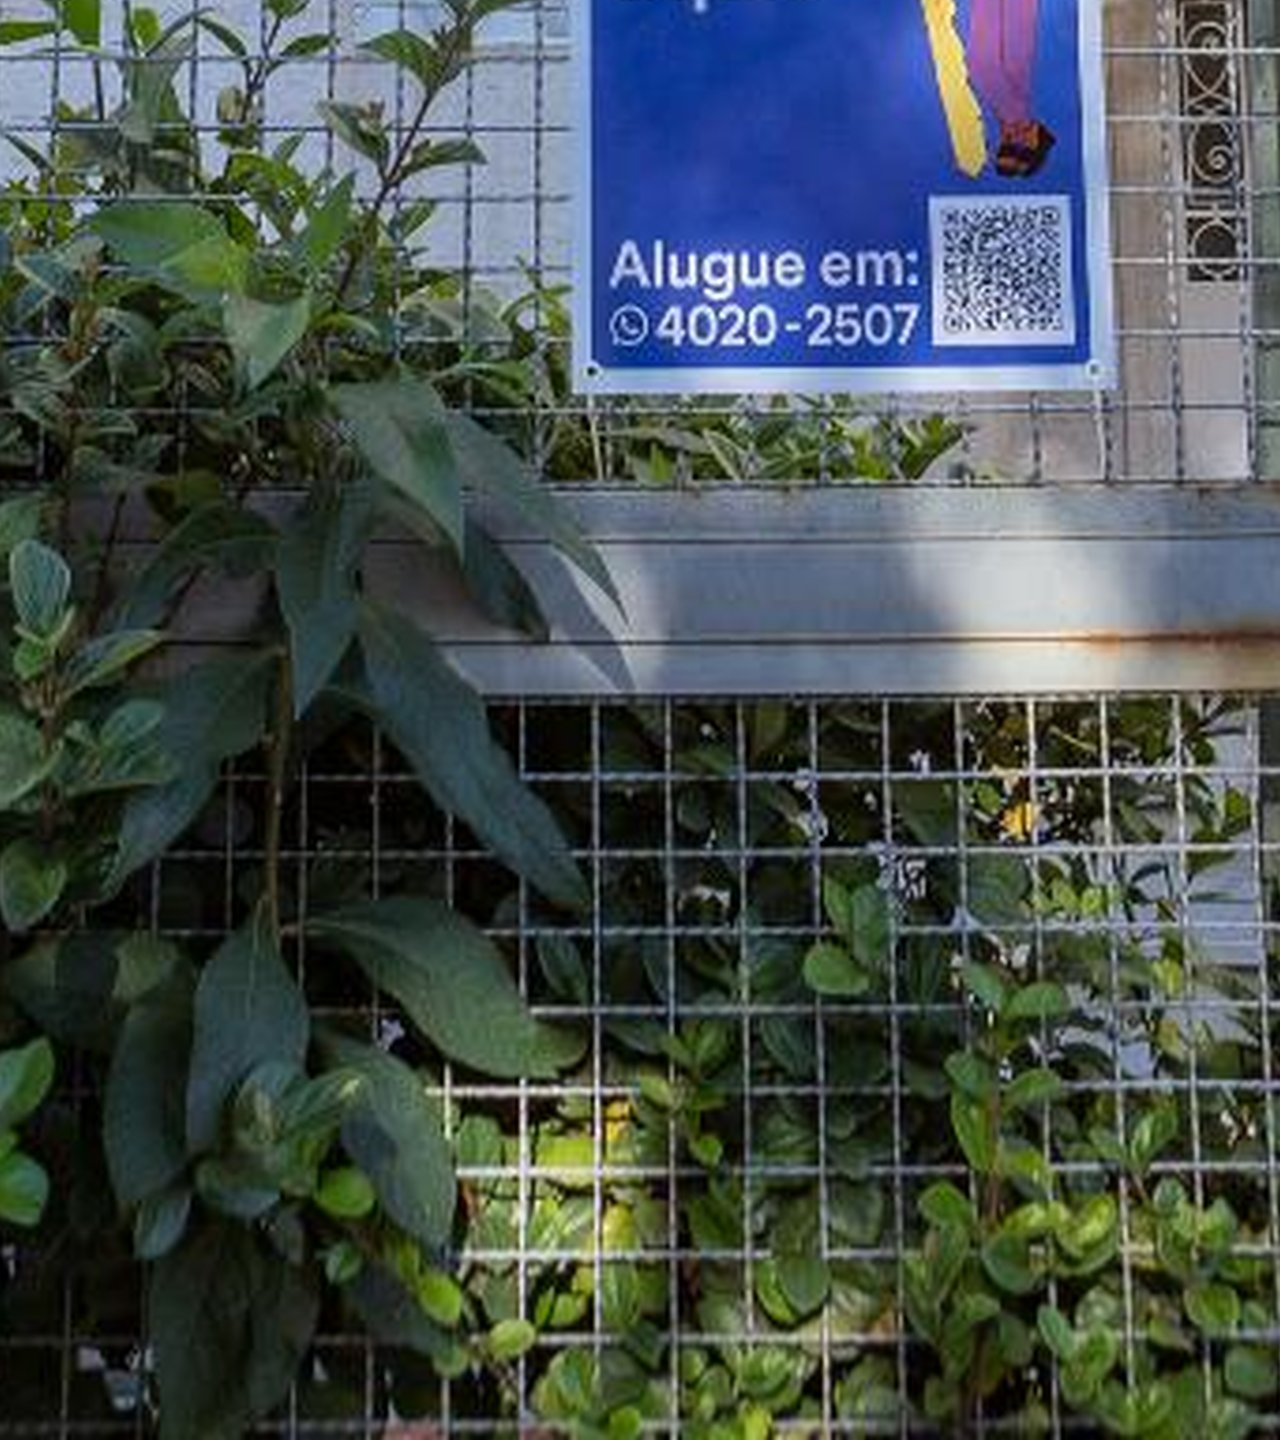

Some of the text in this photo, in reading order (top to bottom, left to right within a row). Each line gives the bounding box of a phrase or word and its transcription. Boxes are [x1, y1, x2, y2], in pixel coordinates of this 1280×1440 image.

[608, 239, 920, 299] Alugue em:
[656, 303, 921, 347] 4020-2507
